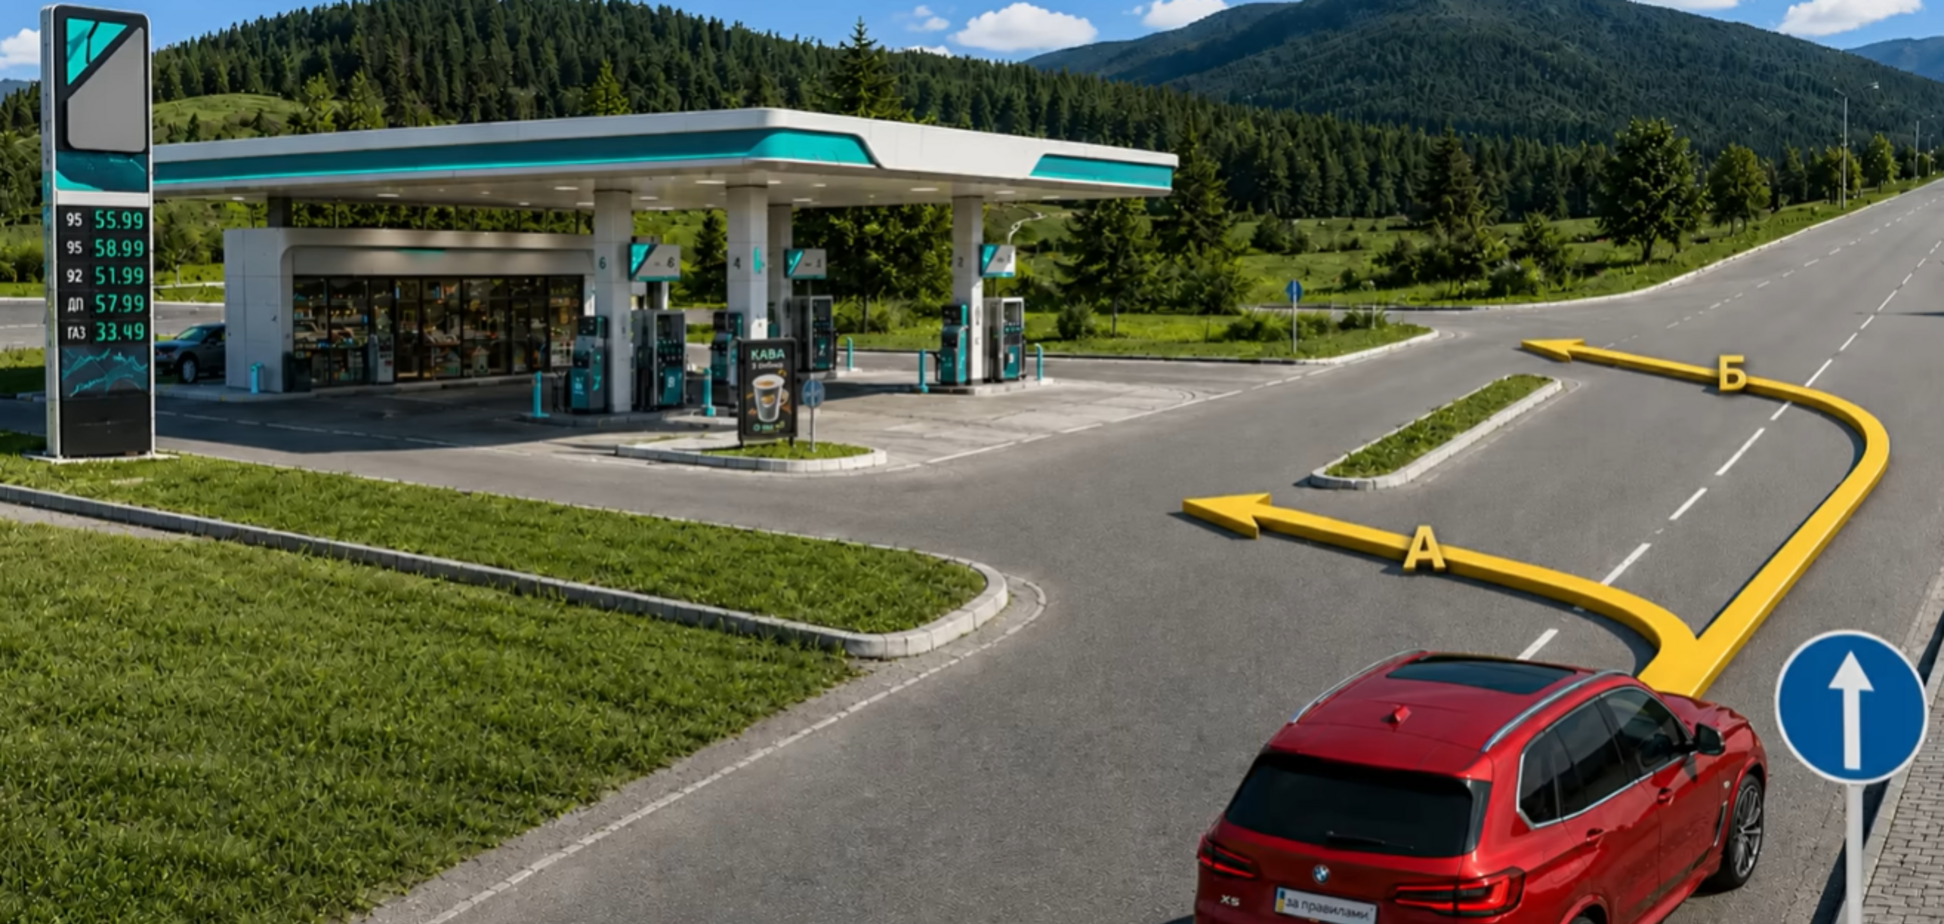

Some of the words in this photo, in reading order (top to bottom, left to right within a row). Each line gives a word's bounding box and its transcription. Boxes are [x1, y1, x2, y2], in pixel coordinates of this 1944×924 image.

[66, 212, 83, 227] 95
[95, 209, 144, 230] 55.99
[66, 240, 83, 255] 95
[95, 239, 144, 258] 58.99
[66, 268, 83, 283] 92
[95, 265, 144, 285] 51.99
[67, 297, 84, 313] ДП
[95, 294, 144, 314] 57.99
[67, 325, 86, 340] ГАЗ
[95, 321, 145, 341] 33.49
[750, 348, 786, 361] КАВА
[1285, 898, 1299, 909] за
